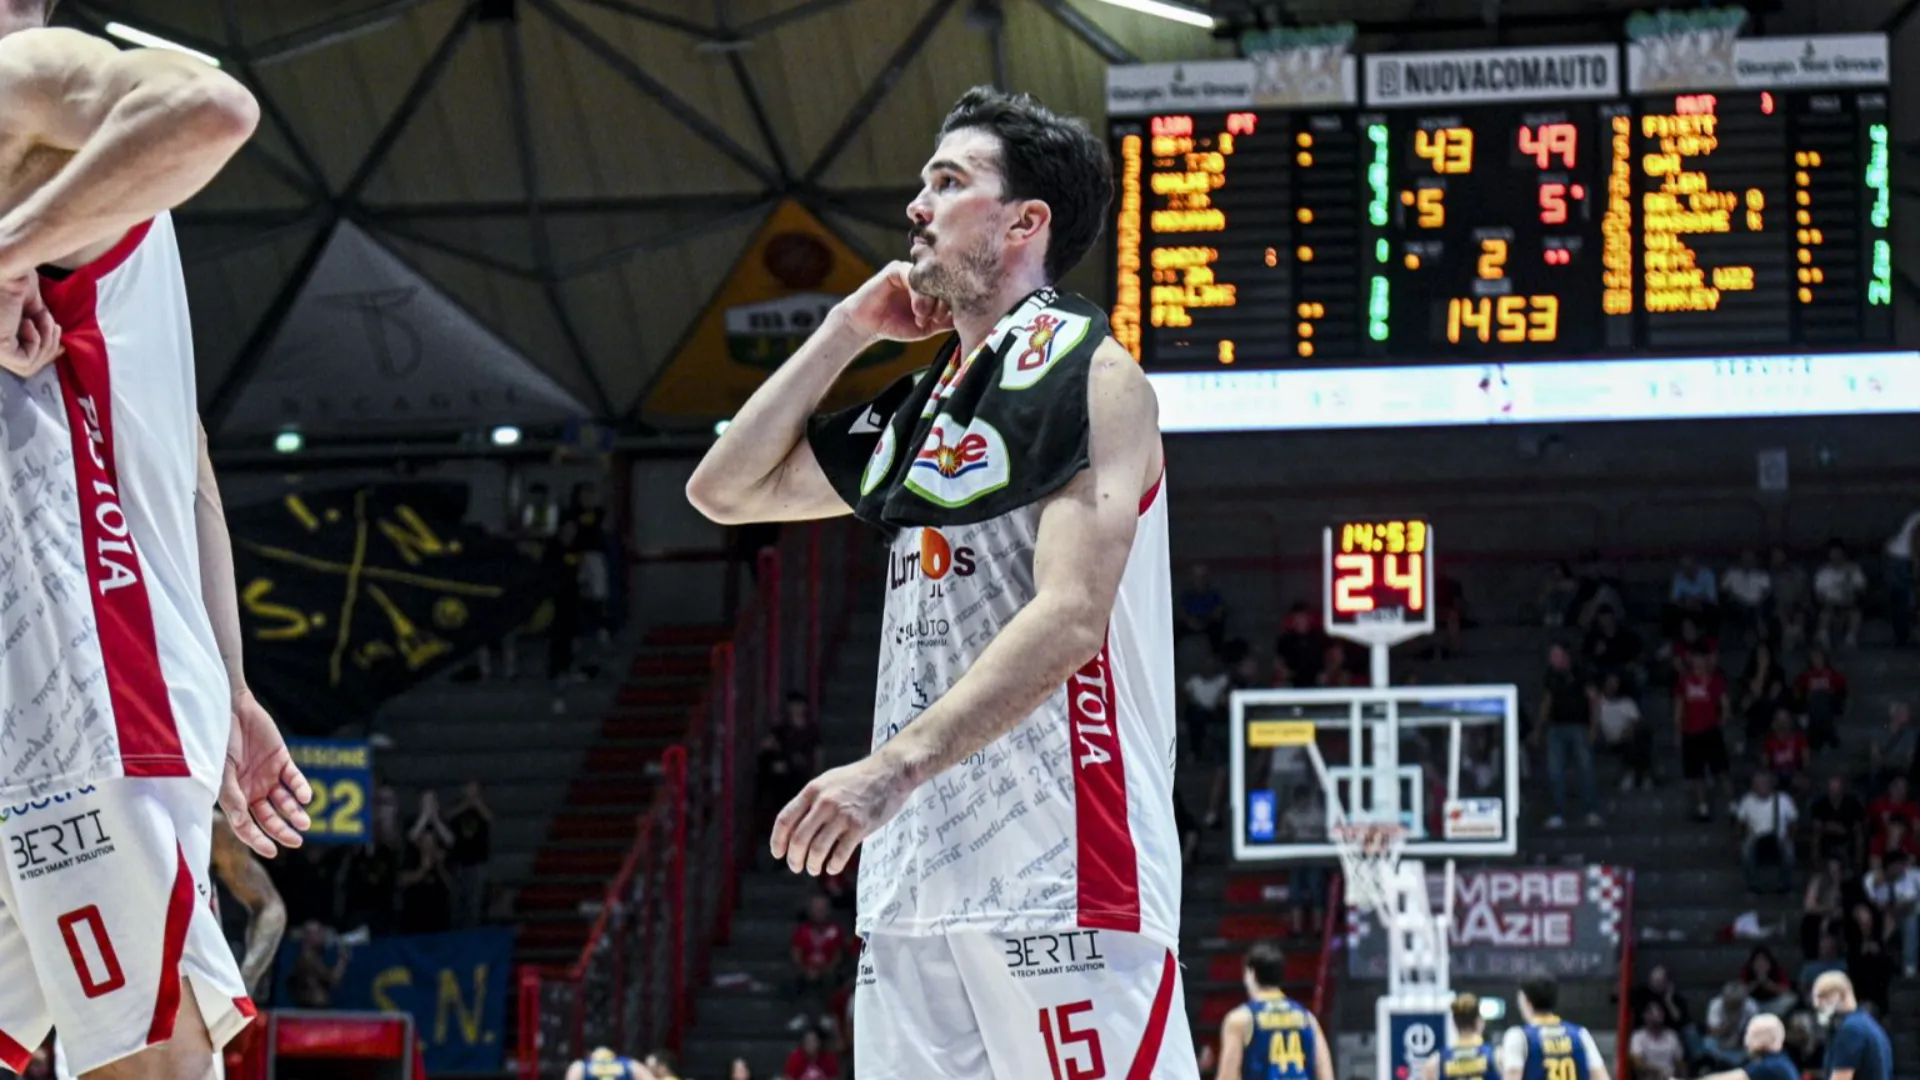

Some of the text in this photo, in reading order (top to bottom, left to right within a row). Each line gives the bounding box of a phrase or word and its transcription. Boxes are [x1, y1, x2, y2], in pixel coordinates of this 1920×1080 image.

[1404, 54, 1608, 95] NUOVACOMAUTO
[1414, 126, 1475, 174] 43
[1517, 123, 1577, 169] 49
[1416, 187, 1446, 229] 5
[1539, 183, 1567, 225] 5
[1477, 239, 1508, 280] 2
[1341, 520, 1426, 553] 14:53
[1335, 553, 1423, 612] 24
[308, 778, 367, 834] 22
[10, 808, 111, 869] BERTI
[46, 857, 74, 874] SMART
[76, 844, 115, 864] SOLUTION
[57, 903, 126, 998] 0
[1005, 930, 1104, 968] BERTI
[1037, 966, 1063, 976] SMART
[1065, 962, 1105, 973] SOLUTION
[1038, 999, 1106, 1080] 15
[1269, 1030, 1306, 1075] 44
